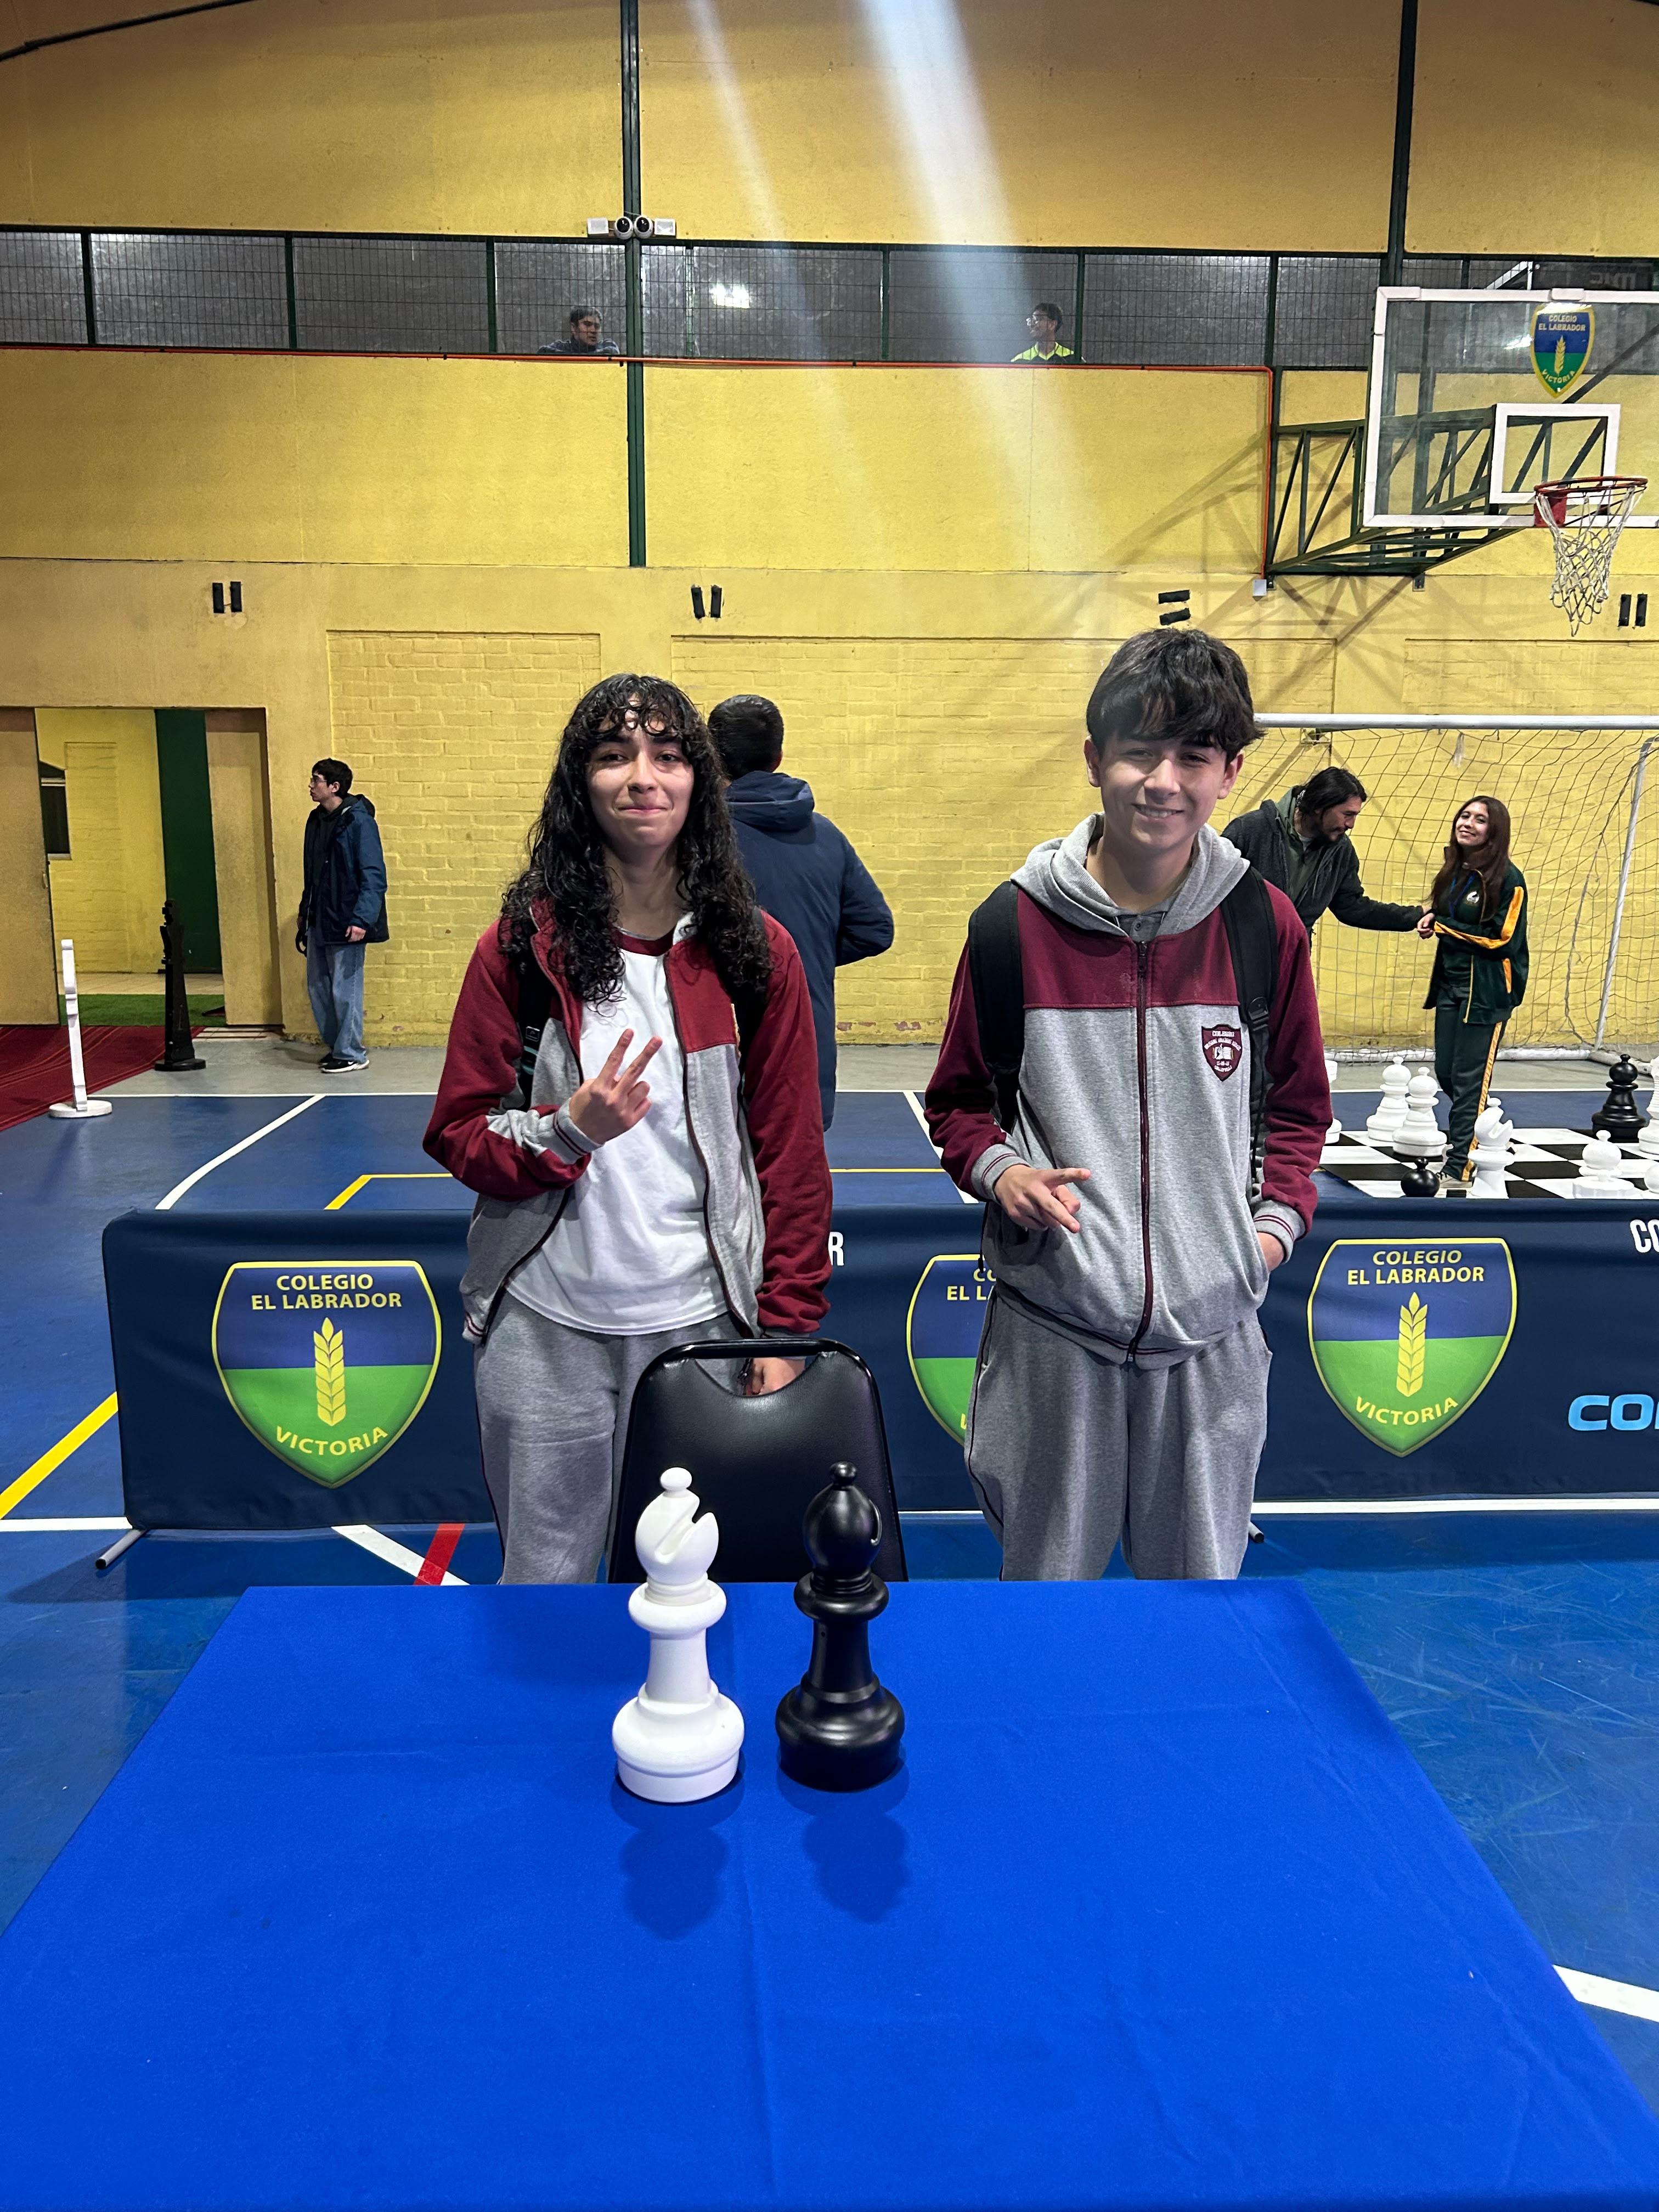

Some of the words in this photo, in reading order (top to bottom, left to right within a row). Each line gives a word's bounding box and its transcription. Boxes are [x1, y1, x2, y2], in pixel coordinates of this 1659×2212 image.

[1542, 369, 1576, 383] VICTORIA
[1373, 1250, 1462, 1266] COLEGIO
[276, 1274, 373, 1291] COLEGIO
[1347, 1269, 1370, 1285] EL
[1375, 1267, 1484, 1284] LABRADOR
[251, 1295, 276, 1310] EL
[283, 1293, 402, 1309] LABRADOR
[947, 1286, 970, 1300] EL
[1355, 1396, 1458, 1425] VICTORIA
[276, 1426, 388, 1455] VICTORIA
